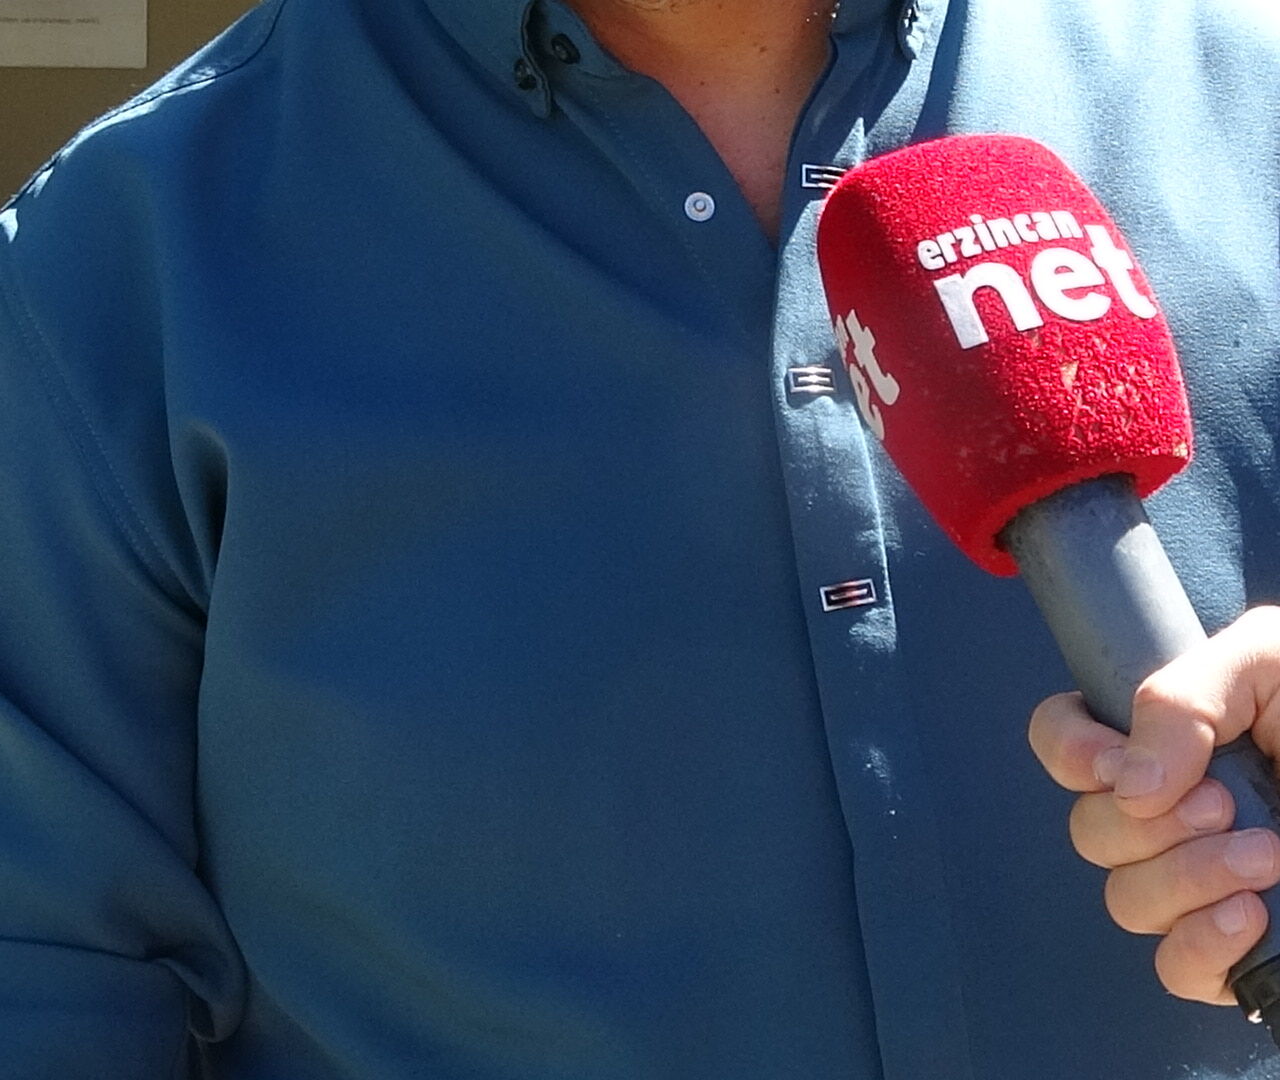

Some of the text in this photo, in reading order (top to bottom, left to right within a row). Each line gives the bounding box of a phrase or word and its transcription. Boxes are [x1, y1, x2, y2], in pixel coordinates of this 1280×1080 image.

[917, 210, 1083, 271] erzincan
[932, 223, 1158, 350] net
[846, 308, 900, 441] et
